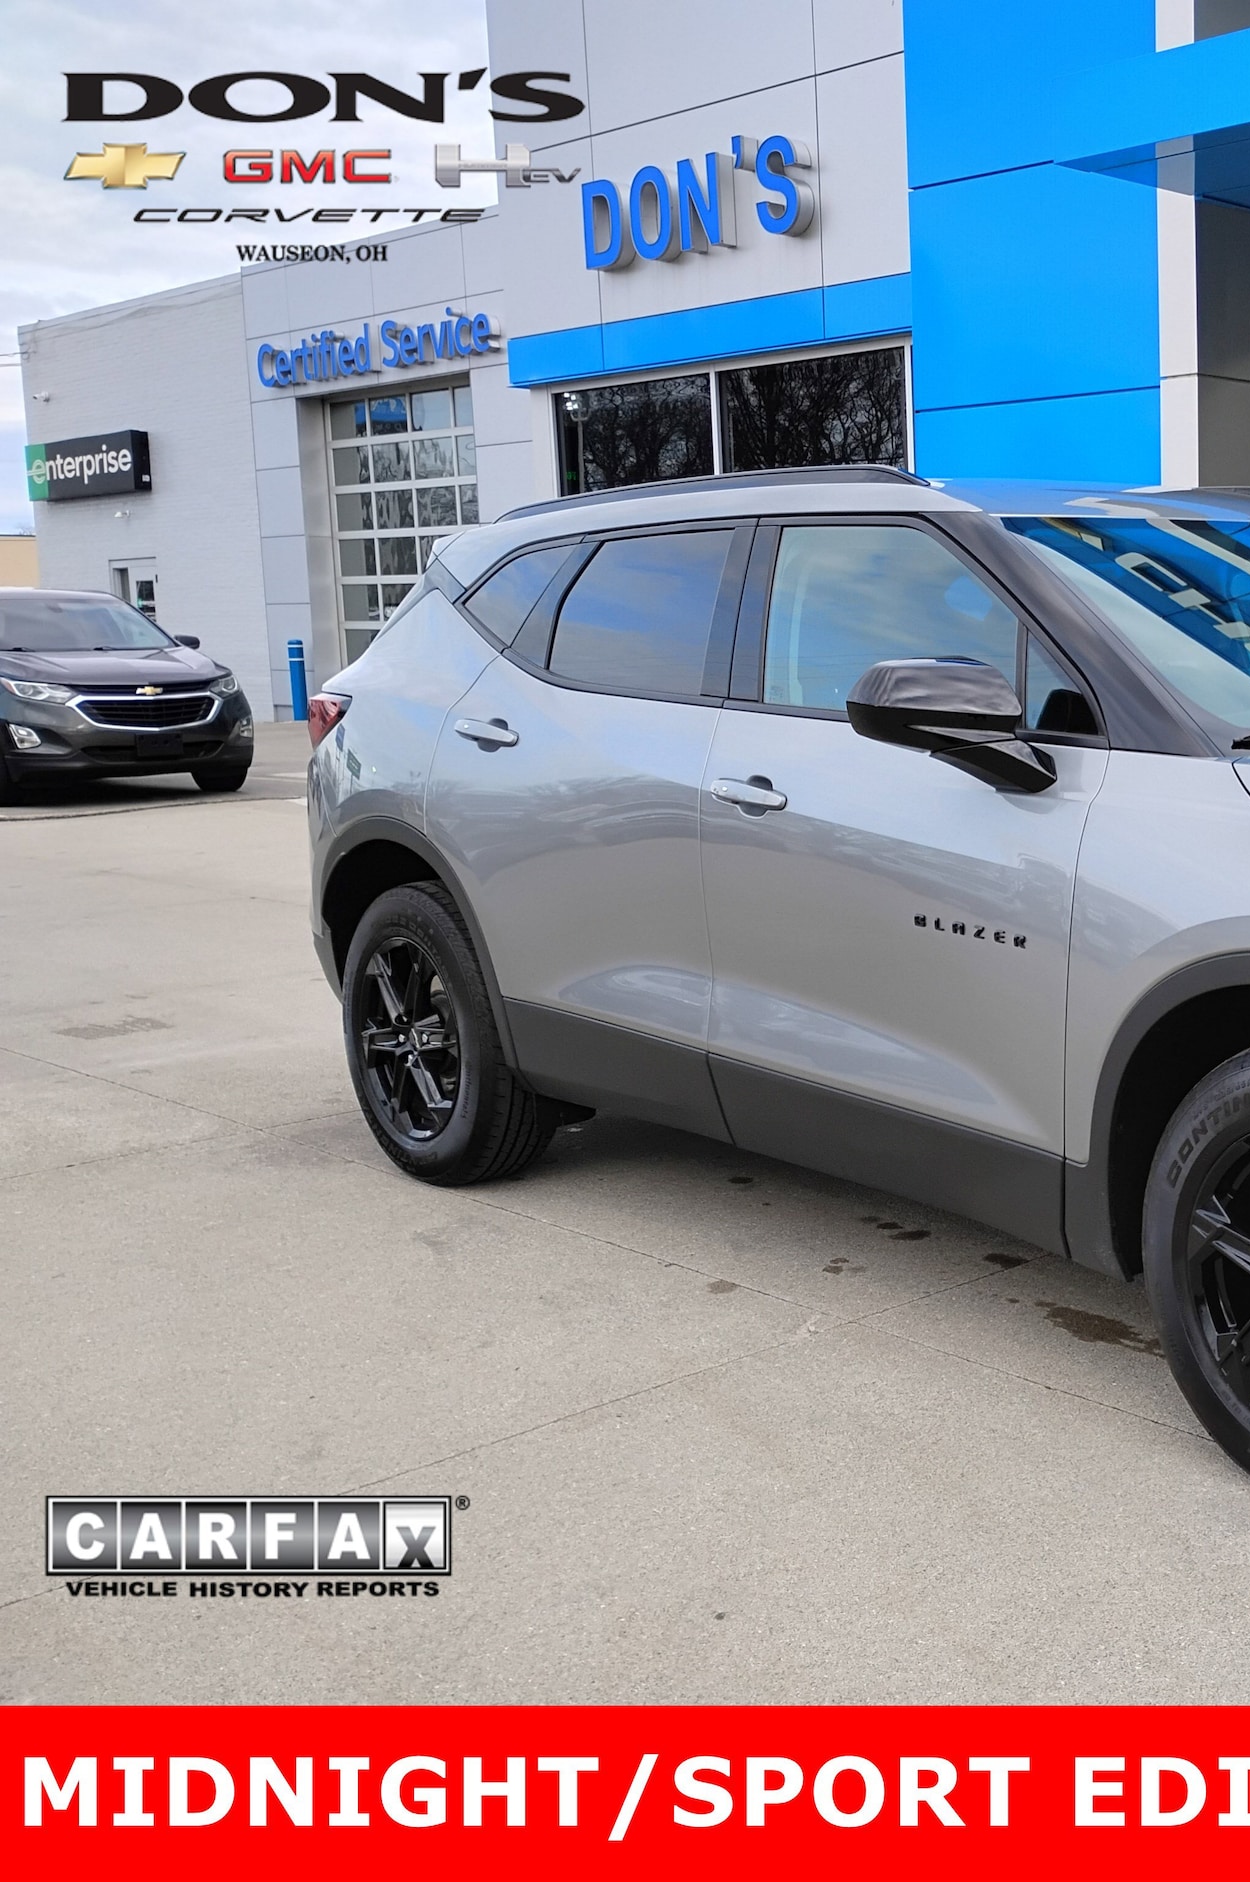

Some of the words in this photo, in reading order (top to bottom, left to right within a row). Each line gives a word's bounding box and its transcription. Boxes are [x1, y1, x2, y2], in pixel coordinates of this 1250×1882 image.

[581, 134, 802, 270] DON'S
[257, 322, 372, 388] Certified
[380, 306, 491, 368] Service
[28, 444, 133, 485] enterprise
[914, 914, 1027, 949] BLAZER
